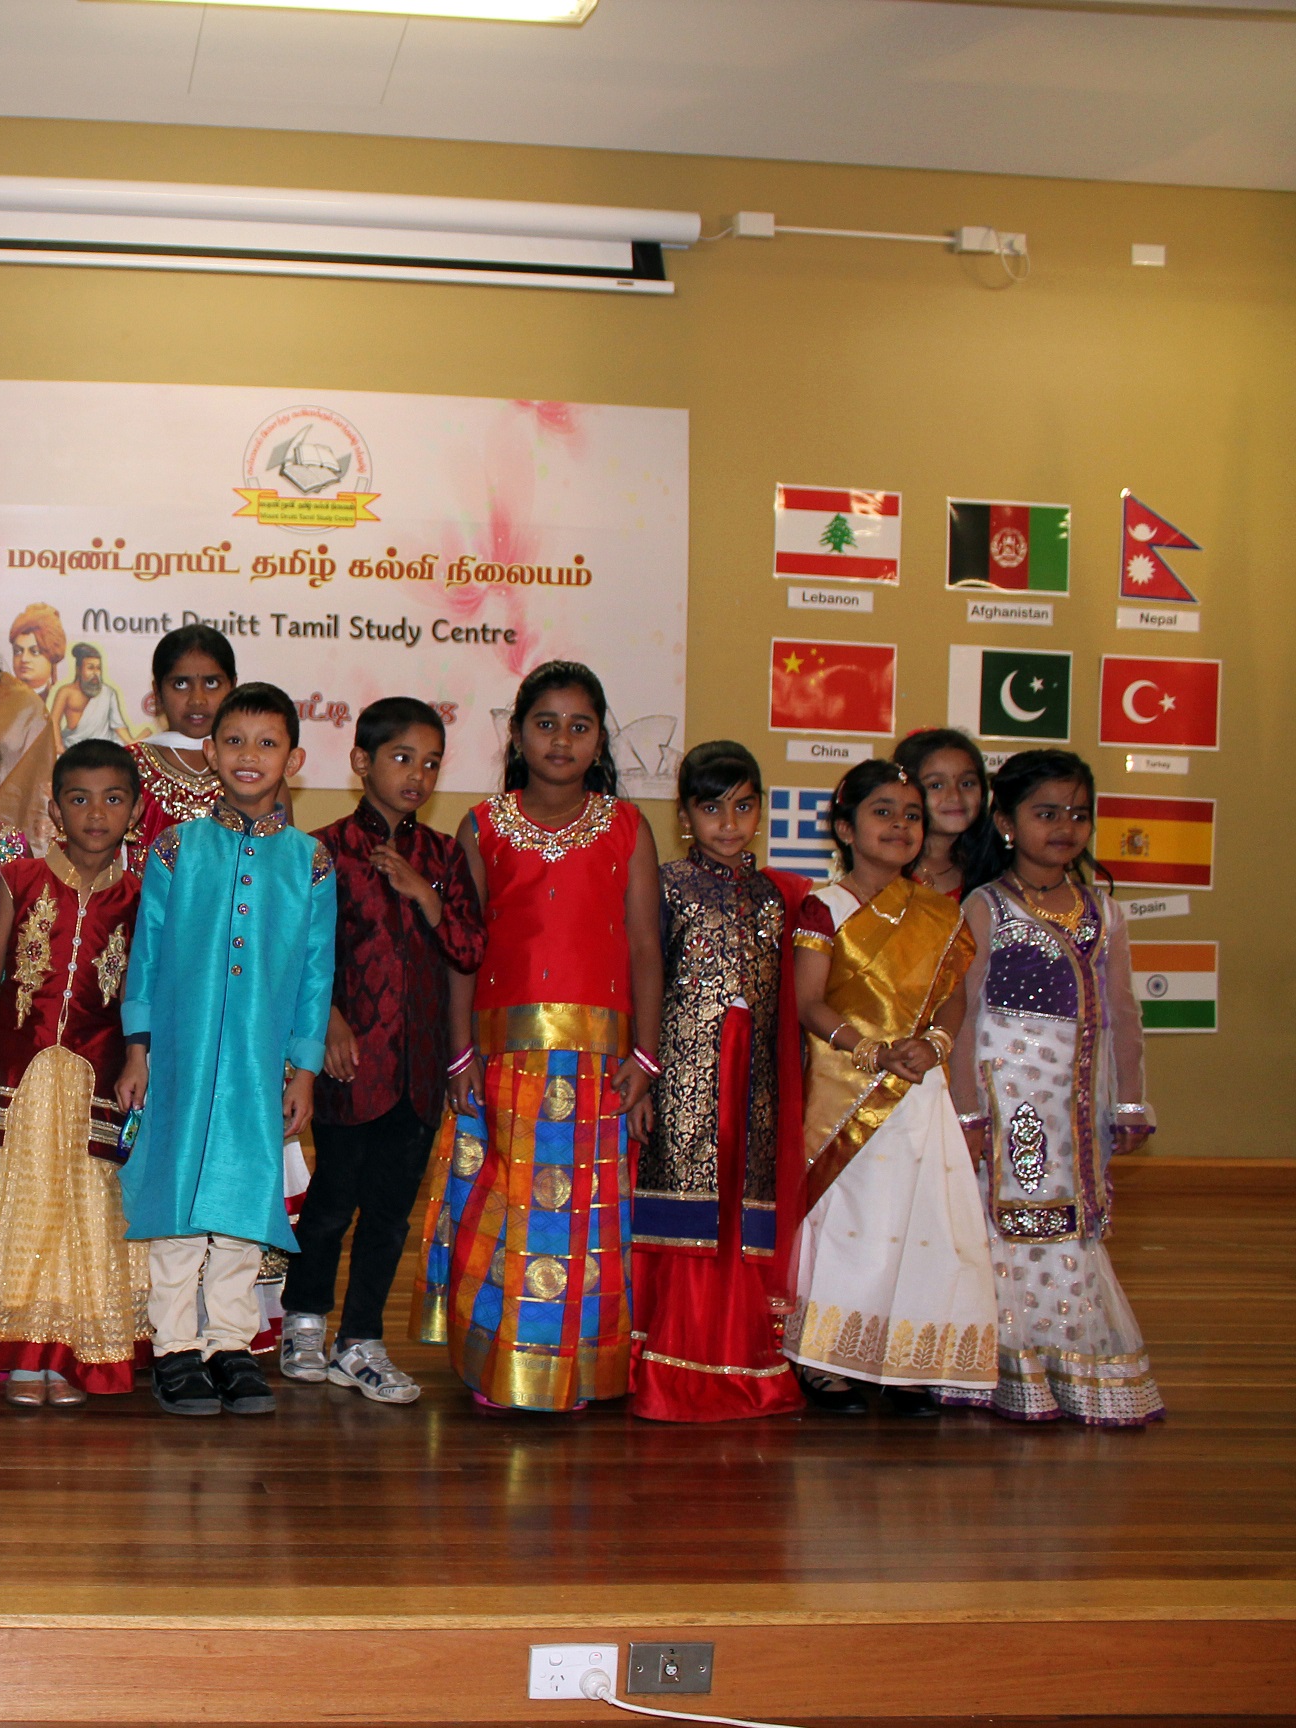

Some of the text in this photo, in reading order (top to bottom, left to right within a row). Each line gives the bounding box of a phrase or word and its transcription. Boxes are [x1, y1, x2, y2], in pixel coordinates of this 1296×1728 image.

[249, 543, 337, 588] தமிழ்
[348, 546, 440, 581] கல்வி
[445, 554, 593, 590] நிலையம்
[802, 590, 860, 606] Lebanon
[971, 604, 1049, 619] Afghanistan
[1139, 611, 1178, 627] Nepal
[82, 607, 172, 634] Mount
[269, 612, 341, 639] Tamil
[349, 614, 423, 648] Study
[431, 617, 519, 645] Centre
[811, 743, 850, 758] China
[1129, 901, 1167, 916] Spain
